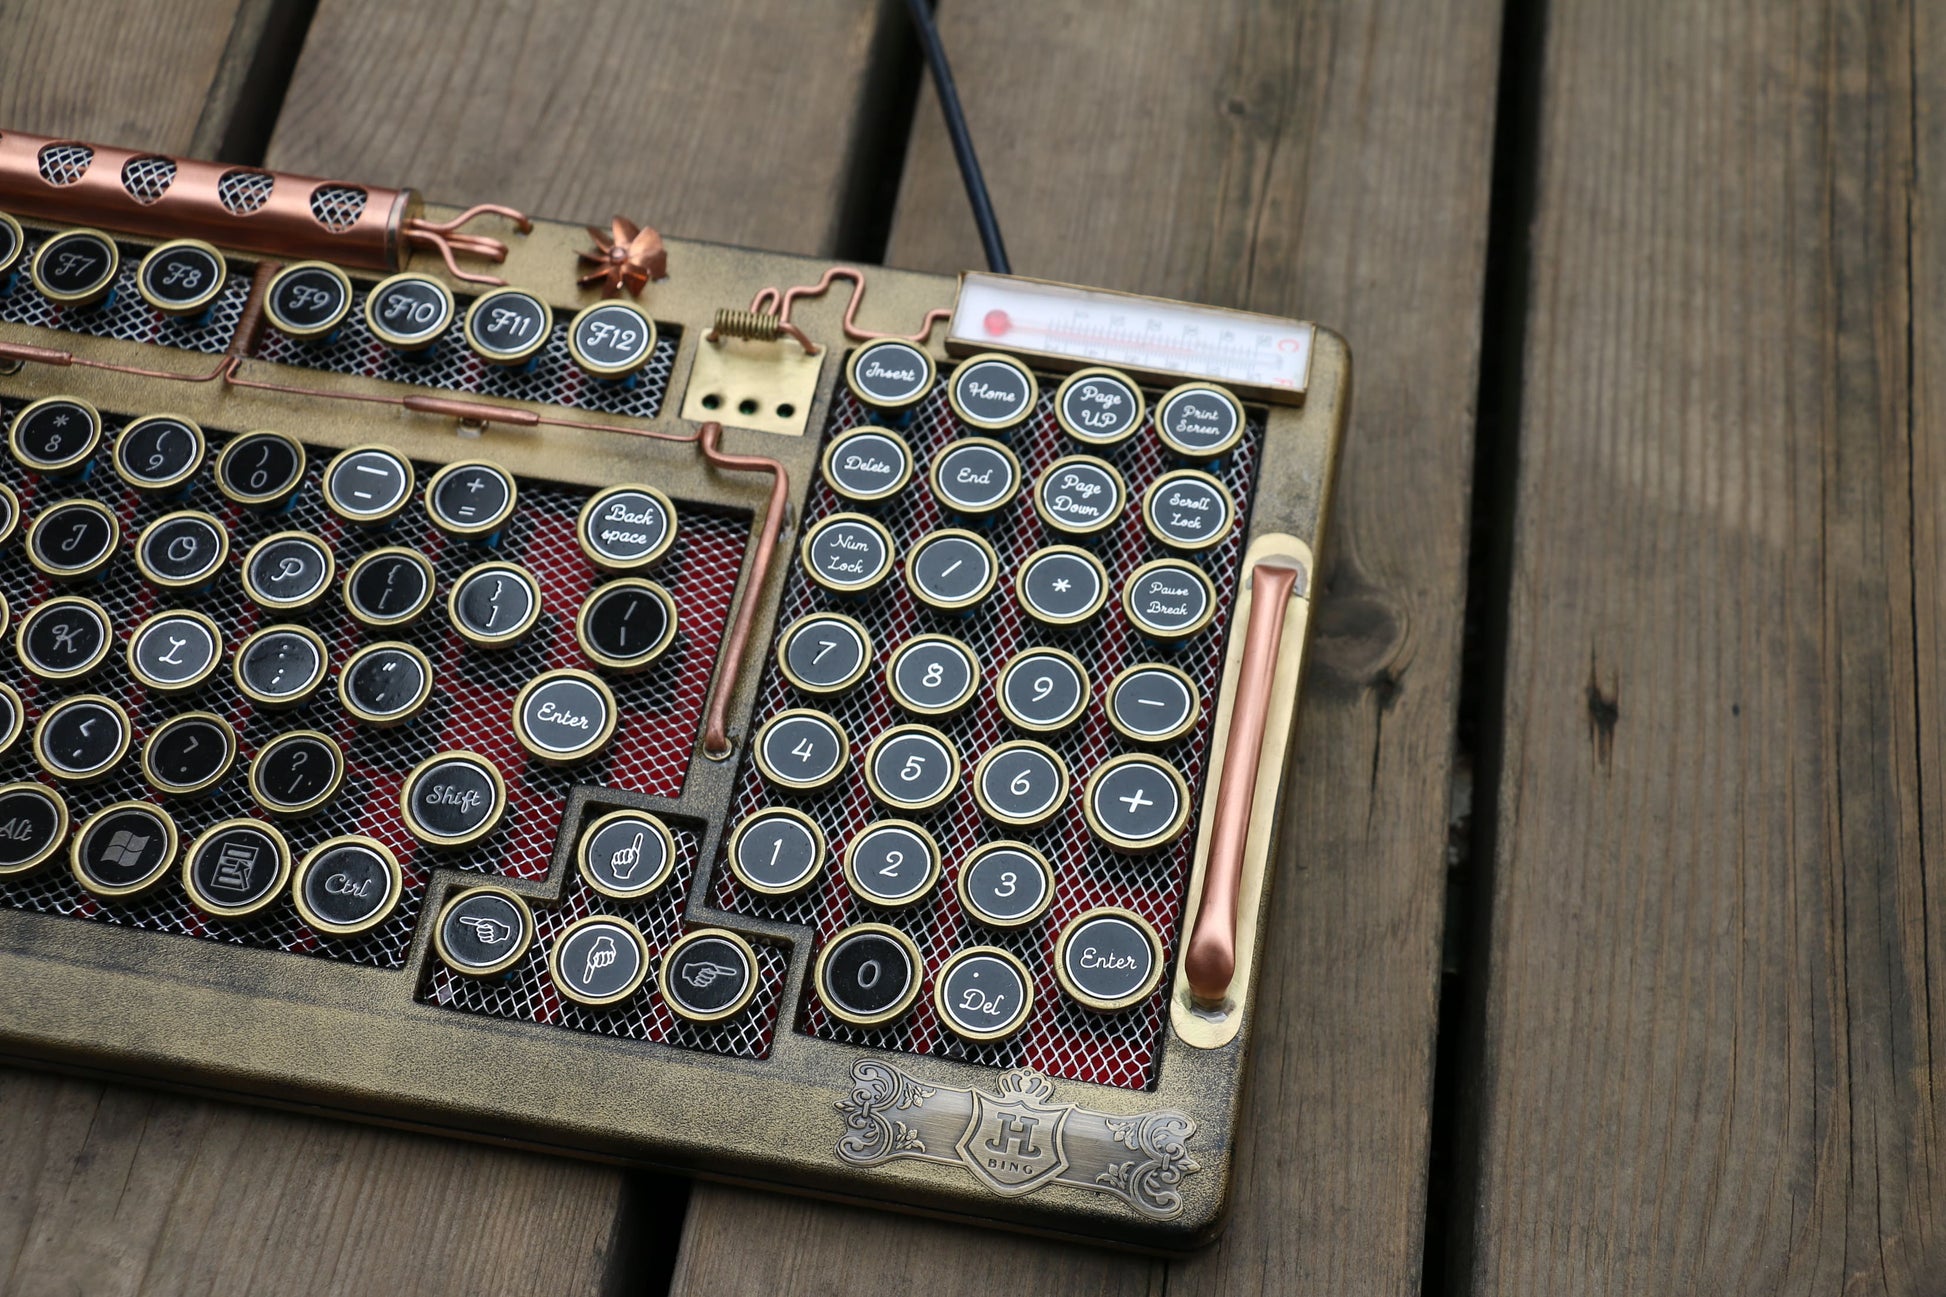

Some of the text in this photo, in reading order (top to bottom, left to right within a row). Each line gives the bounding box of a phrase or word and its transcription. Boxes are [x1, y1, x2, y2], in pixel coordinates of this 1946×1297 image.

[55, 252, 97, 277] F7
[162, 262, 201, 287] F8
[289, 285, 330, 311] F9
[384, 294, 435, 322] F10
[488, 309, 530, 336] F11
[586, 321, 637, 351] F12
[866, 362, 914, 381] Insert
[969, 382, 1015, 402] Home
[1081, 385, 1122, 409] Page
[1181, 405, 1219, 420] Print
[1176, 418, 1220, 435] Screen
[45, 434, 61, 452] 8
[146, 454, 164, 471] 9
[845, 456, 890, 473] Delete
[251, 470, 267, 488] 0
[957, 468, 992, 485] End
[1061, 474, 1102, 498] Page
[1053, 496, 1099, 517] Down
[1170, 493, 1210, 510] Scroll
[604, 504, 654, 526] Back
[1171, 513, 1201, 529] Lock
[601, 528, 647, 546] space
[830, 534, 869, 552] Num
[168, 537, 197, 561] O
[271, 558, 304, 581] P
[828, 556, 863, 573] Lock
[1150, 582, 1188, 595] Pause
[1147, 601, 1187, 615] Break
[52, 625, 83, 653] K
[159, 637, 186, 664] L
[813, 641, 836, 664] 7
[923, 663, 943, 687] 8
[1032, 677, 1053, 701] 9
[538, 702, 588, 729] Enter
[792, 738, 813, 762] 4
[901, 756, 925, 781] 5
[1011, 770, 1030, 795] 6
[426, 786, 480, 813] Shift
[0, 818, 32, 841] Alt
[771, 839, 782, 865] 1
[879, 851, 903, 877] 2
[325, 874, 372, 897] Ctrl
[995, 872, 1016, 897] 3
[1081, 948, 1137, 969] Enter
[858, 960, 880, 988] 0
[959, 989, 1004, 1015] Del
[988, 1158, 1033, 1175] BING
